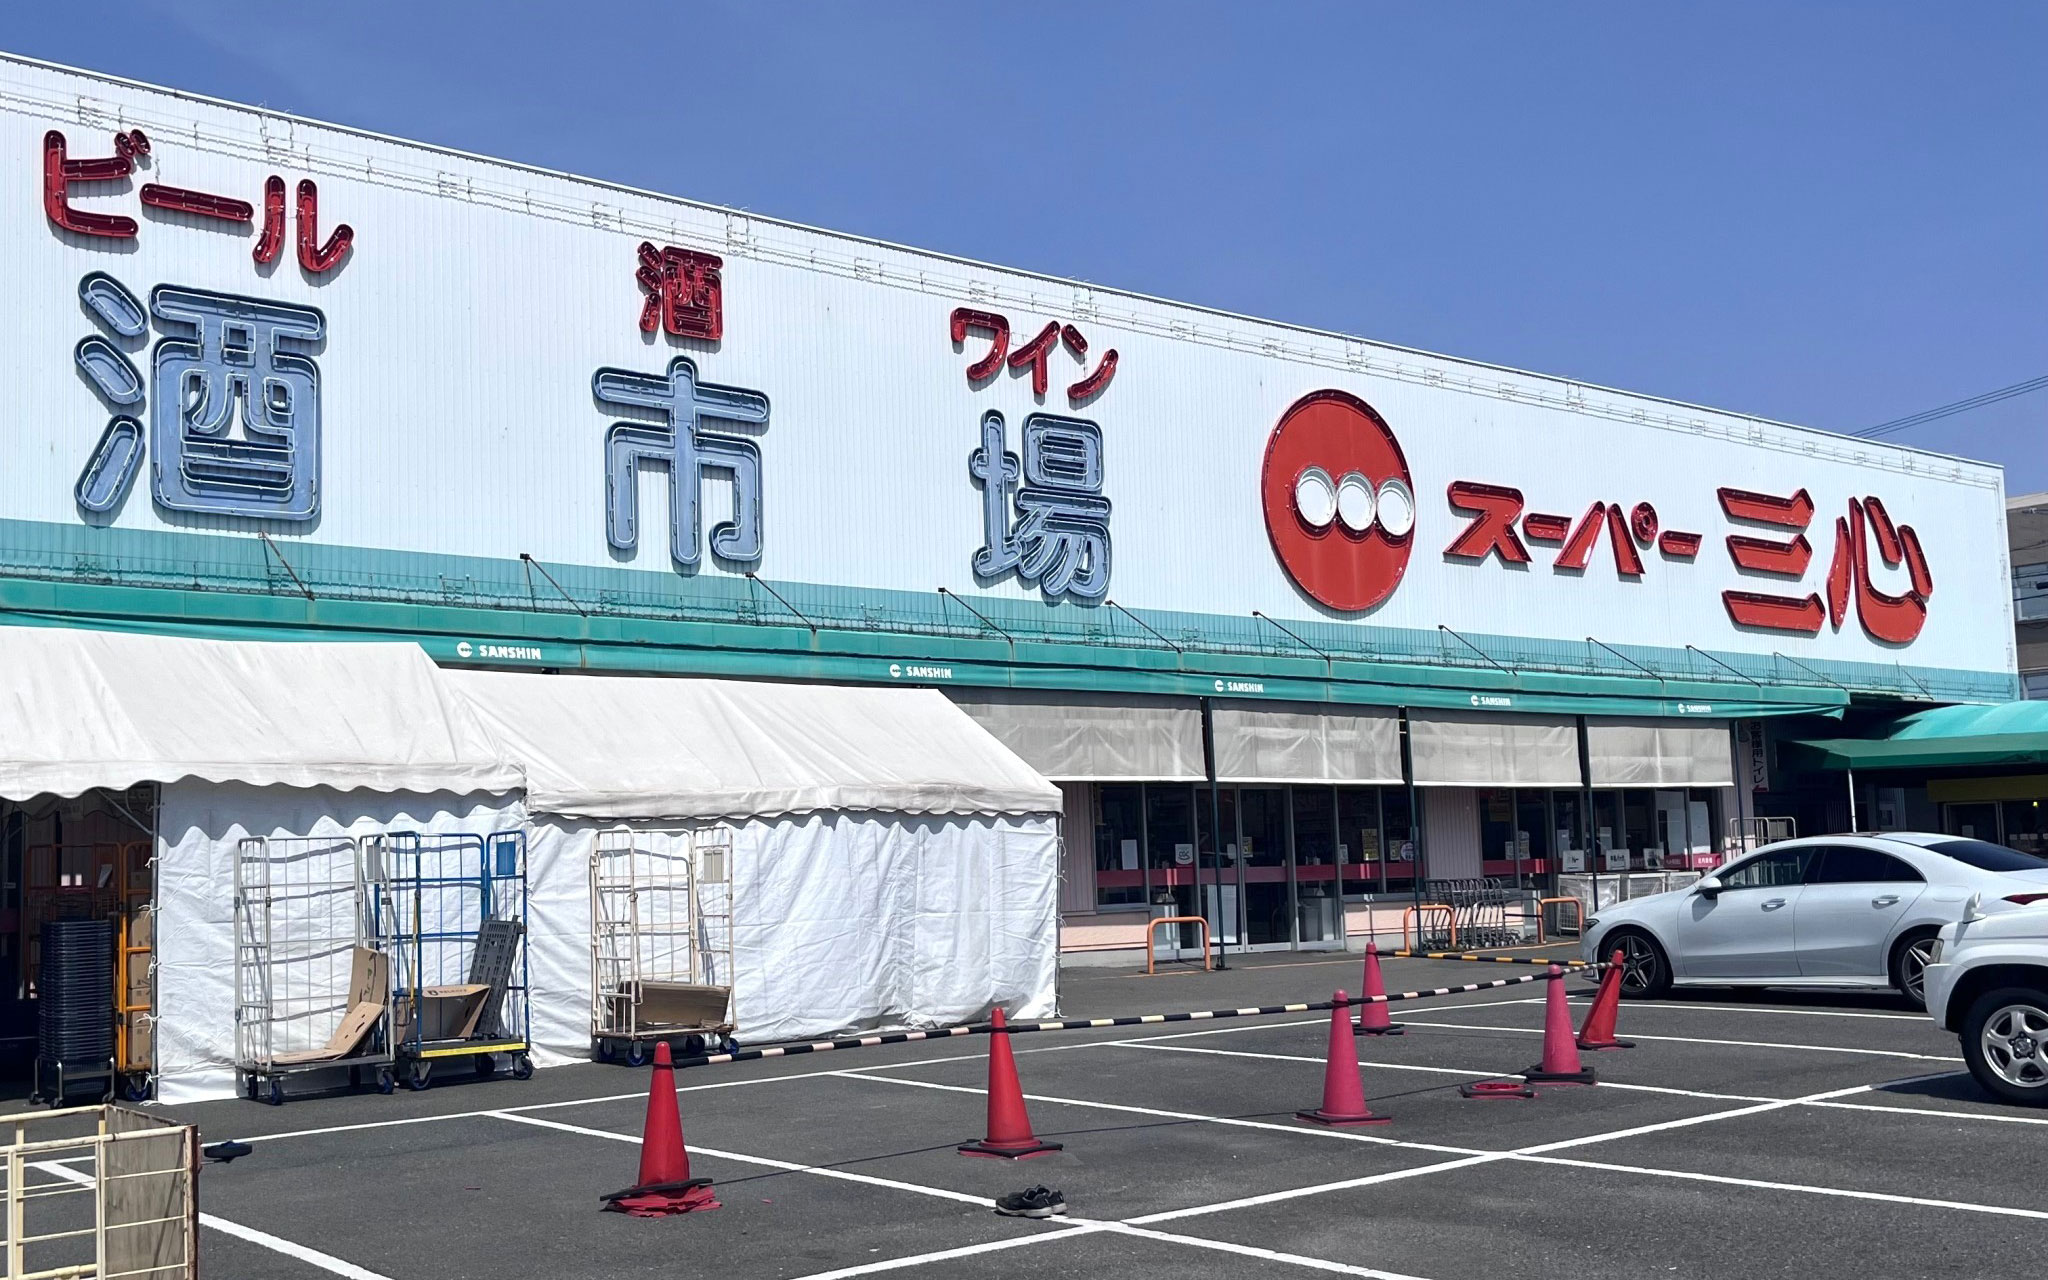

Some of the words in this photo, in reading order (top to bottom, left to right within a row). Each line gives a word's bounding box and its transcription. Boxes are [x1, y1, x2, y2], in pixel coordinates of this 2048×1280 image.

[44, 129, 354, 273] ビール
[636, 241, 723, 341] 酒
[950, 308, 1119, 401] ワイン
[479, 644, 541, 660] SANSHIN
[906, 665, 952, 678] SANSHIN
[1227, 682, 1264, 693] SANSHIN
[1481, 696, 1512, 707] SANSHIN
[1751, 721, 1765, 784] お客様用トイレ
